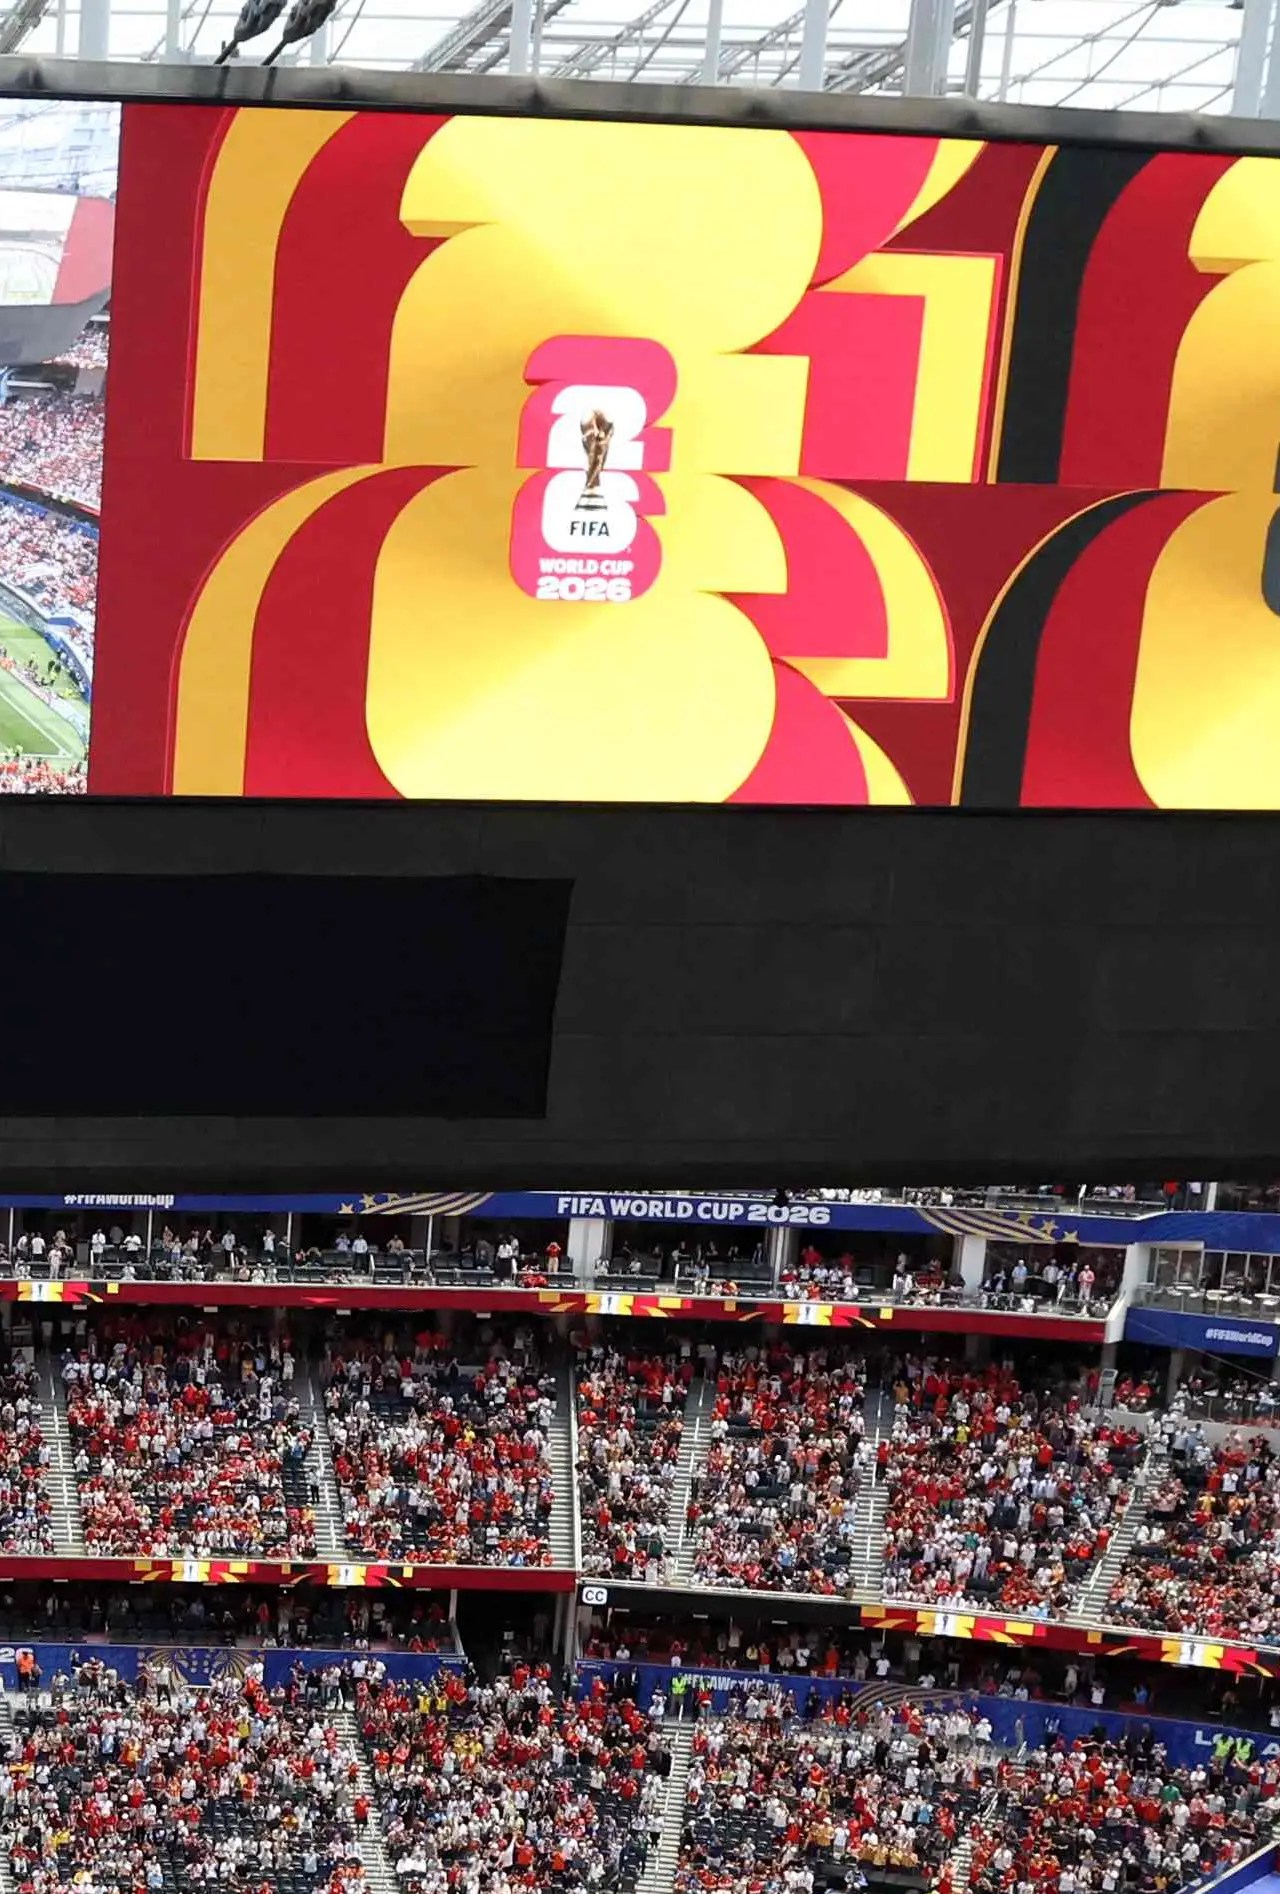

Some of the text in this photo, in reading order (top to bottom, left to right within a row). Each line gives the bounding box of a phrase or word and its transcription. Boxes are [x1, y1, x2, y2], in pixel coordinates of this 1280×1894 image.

[569, 521, 610, 537] FIFA
[539, 558, 634, 576] WORLD CUP
[536, 576, 632, 601] 2026
[557, 1197, 831, 1225] FIFA WORLD CUP 2026
[585, 1590, 604, 1602] CC
